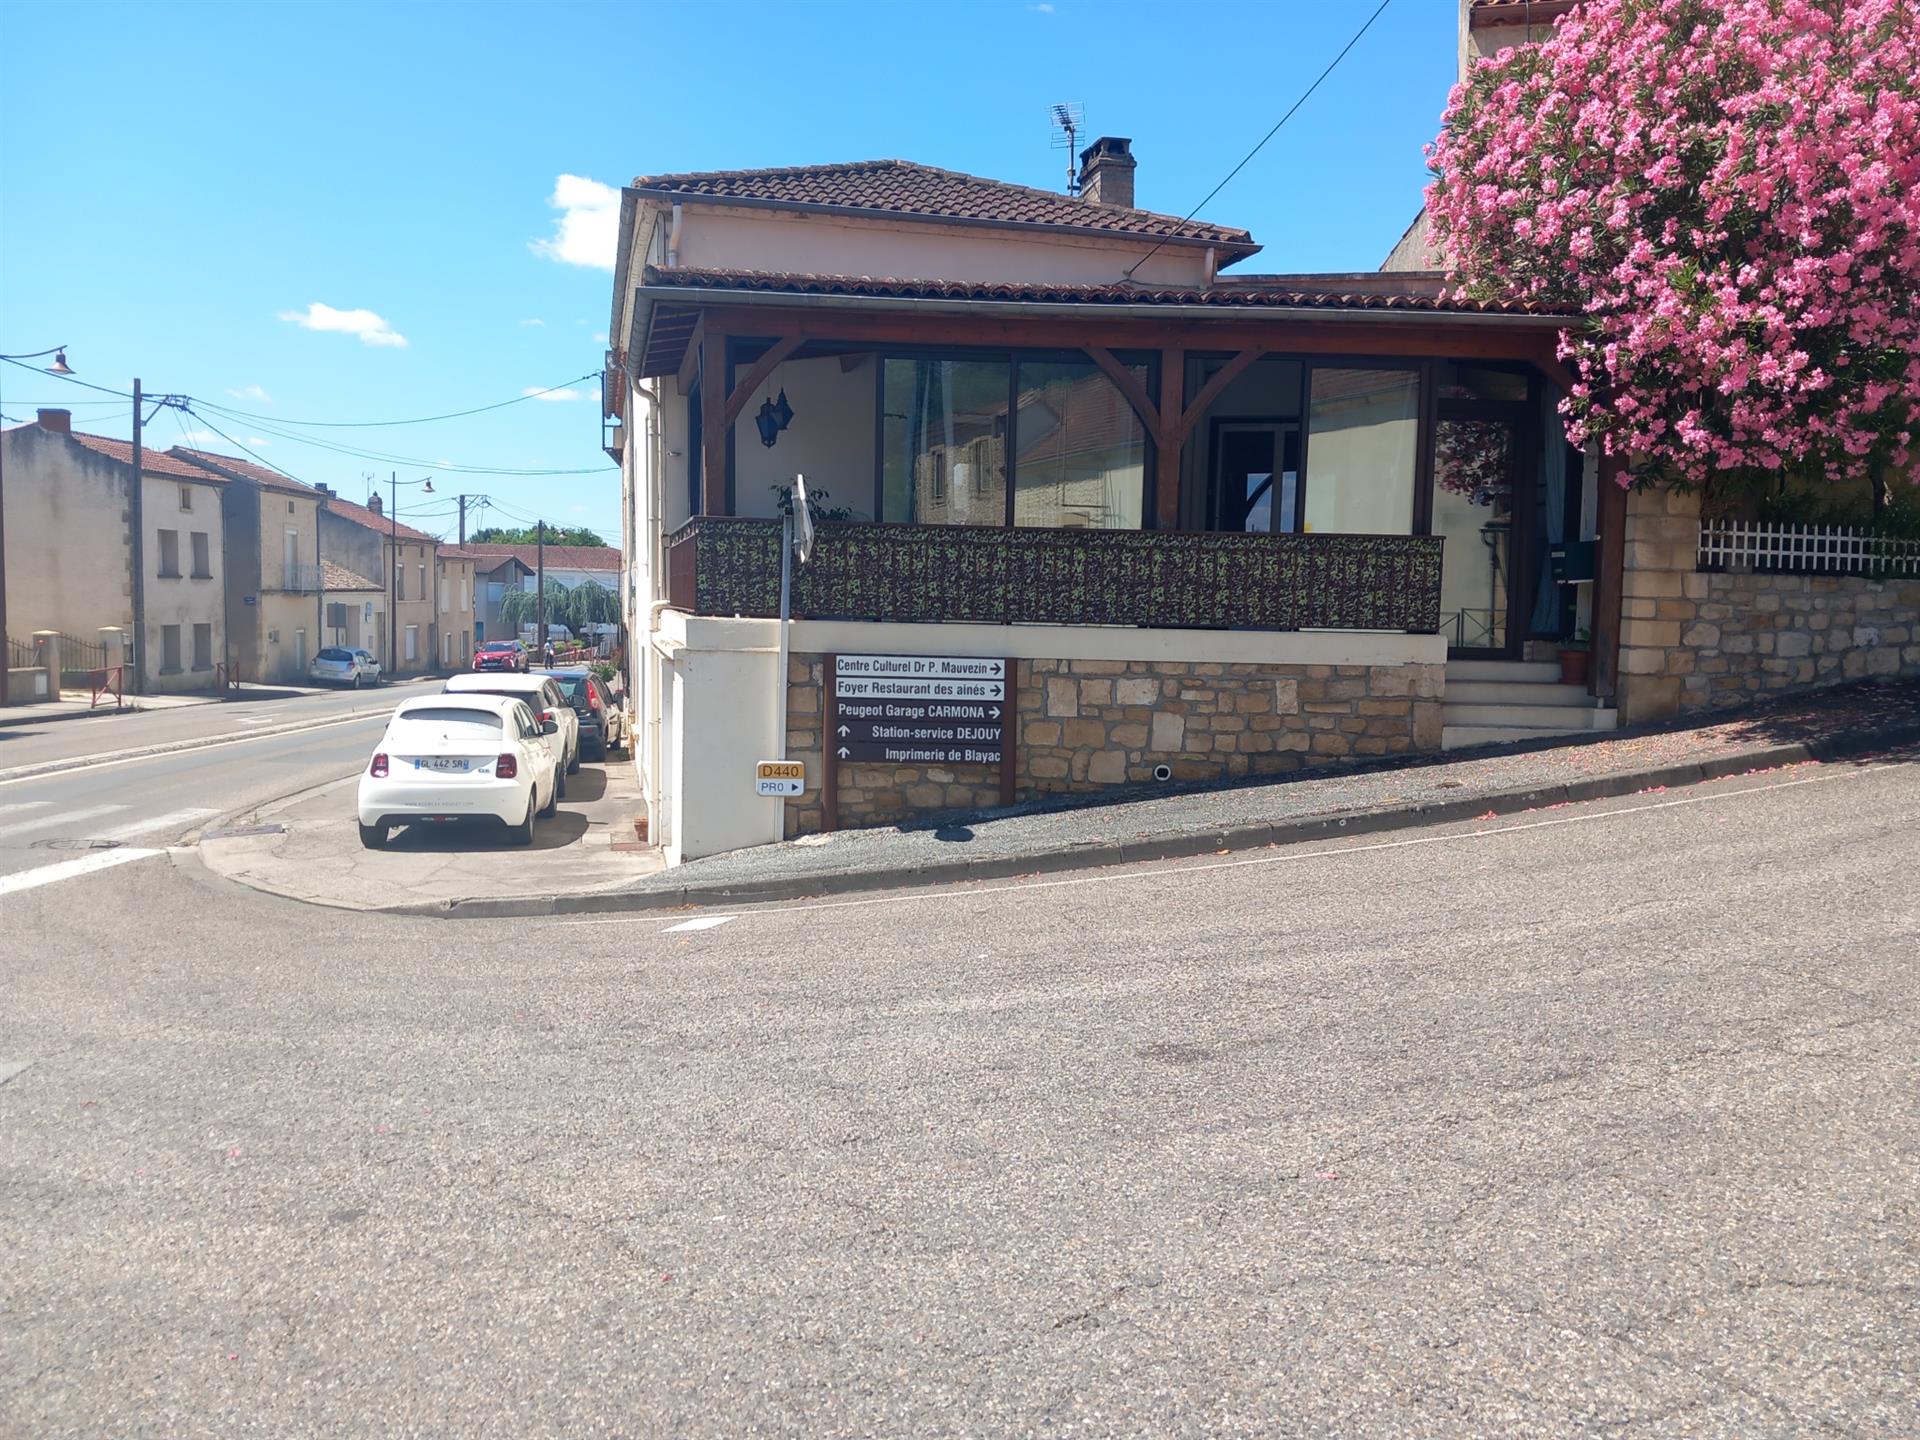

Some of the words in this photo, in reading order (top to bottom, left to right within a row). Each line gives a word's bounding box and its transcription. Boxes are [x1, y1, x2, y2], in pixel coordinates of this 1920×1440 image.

[838, 659, 870, 671] Centre
[873, 660, 910, 672] Culturel
[914, 661, 926, 672] Dr
[929, 661, 938, 673] P.
[941, 661, 987, 674] Mauvezin
[838, 682, 868, 695] Foyer
[873, 682, 931, 694] Restaurant
[934, 683, 952, 695] des
[957, 684, 985, 695] ainés
[839, 703, 882, 717] Peugeot
[886, 705, 924, 718] Garage
[928, 706, 984, 718] CARMONA
[873, 726, 954, 738] Station-service
[957, 728, 1001, 740] DEJOUY
[886, 748, 945, 761] Imprimerie
[948, 749, 961, 761] de
[965, 750, 1001, 764] Blayac
[434, 760, 449, 768] 442
[763, 765, 799, 777] D440
